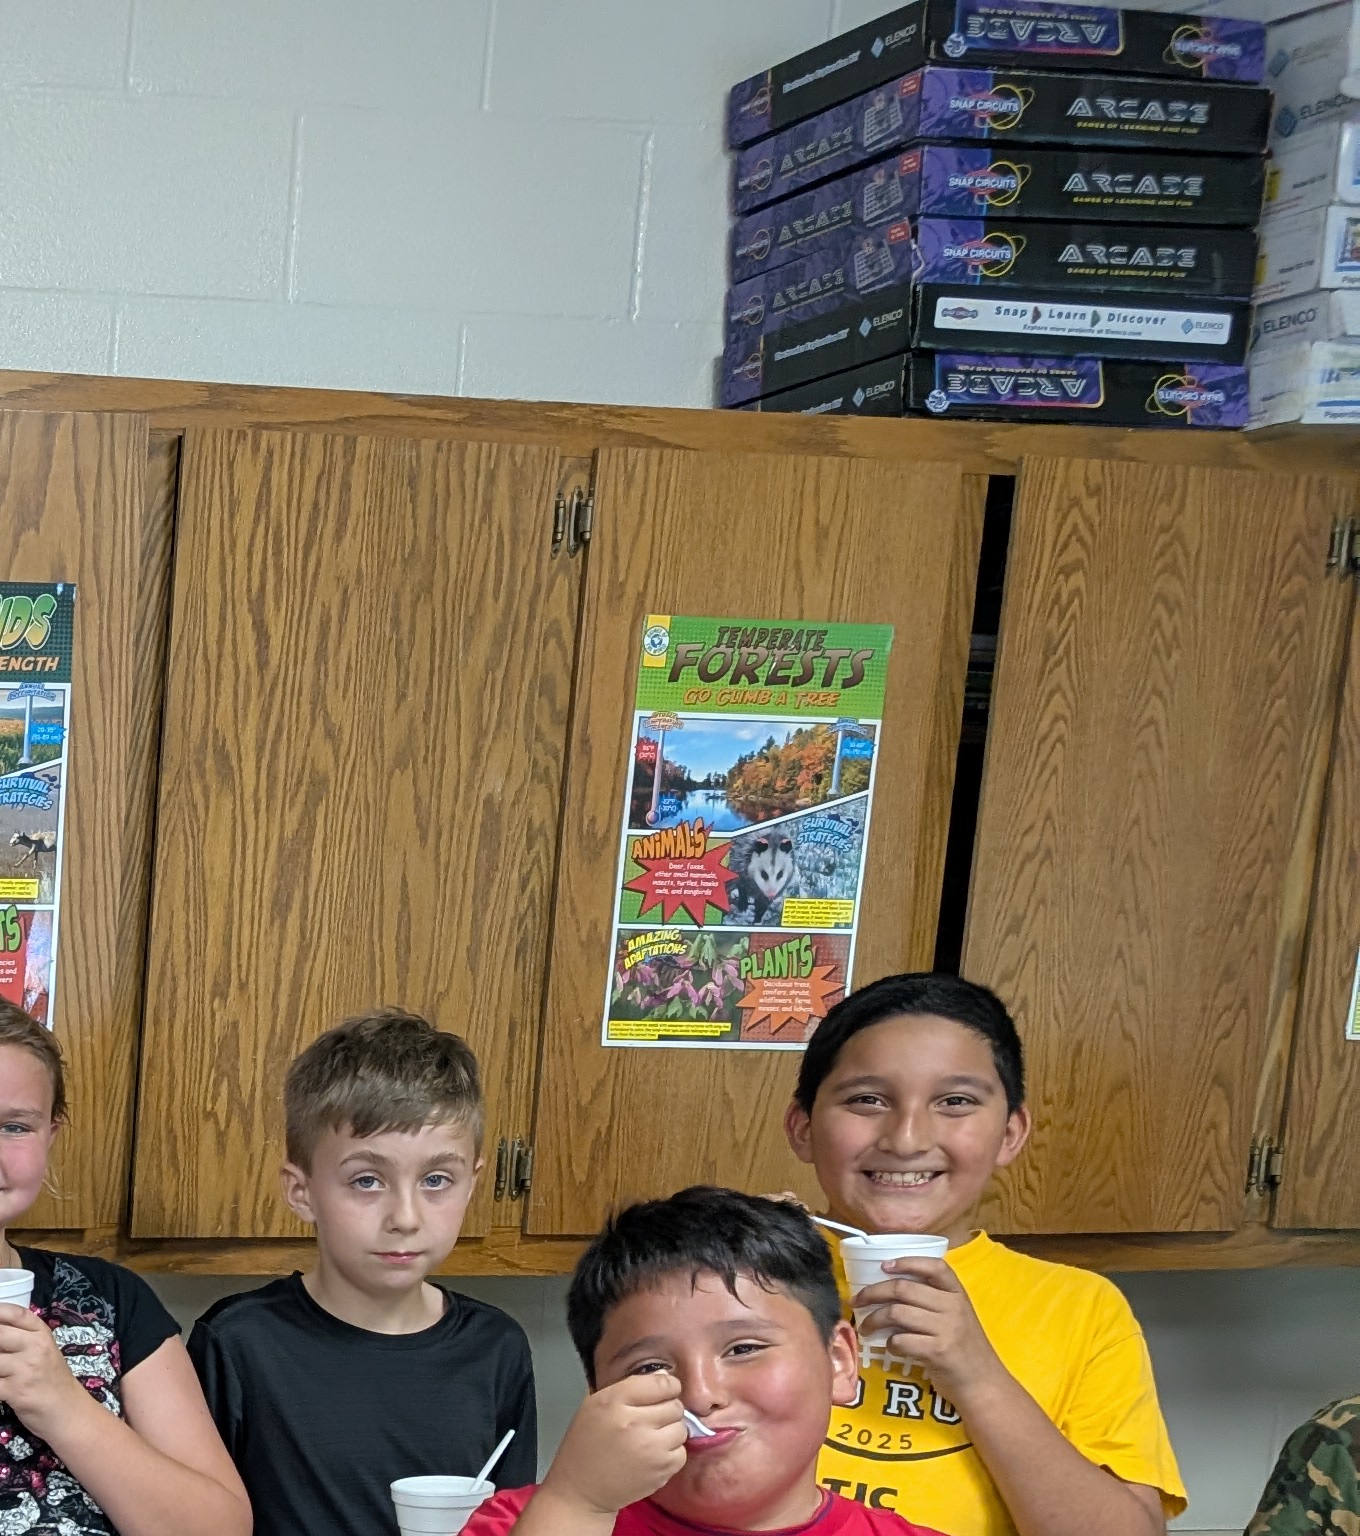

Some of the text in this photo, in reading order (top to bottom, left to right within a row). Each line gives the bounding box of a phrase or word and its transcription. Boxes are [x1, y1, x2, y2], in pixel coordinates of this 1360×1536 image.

[966, 16, 1108, 44] ARCADE
[950, 99, 1019, 112] SNAP CIRCUITS
[1066, 97, 1210, 124] ARCADE
[949, 175, 1017, 189] SNAP CIRCUITS
[1063, 172, 1204, 196] ARCADE
[943, 246, 1012, 260] SNAP CIRCUITS
[1057, 243, 1198, 267] ARCADE
[994, 305, 1028, 319] Snap
[1048, 308, 1086, 321] Learn
[1107, 312, 1167, 326] Discover
[1195, 321, 1224, 331] ELENCO
[1263, 308, 1317, 334] ELENCO
[947, 373, 1087, 397] ARCADE
[716, 626, 828, 650] TEMPERATE
[668, 641, 874, 689] FORESTS
[683, 687, 841, 709] GO CLIMB A TREE
[632, 817, 705, 860] ANIMALS
[803, 817, 854, 837] SURVIVAL
[797, 832, 853, 852] STRATEGIES
[627, 929, 681, 952] AMAZING
[624, 943, 687, 970] ADAPTATIONS
[740, 934, 813, 979] PLANTS
[835, 1423, 913, 1450] 2025
